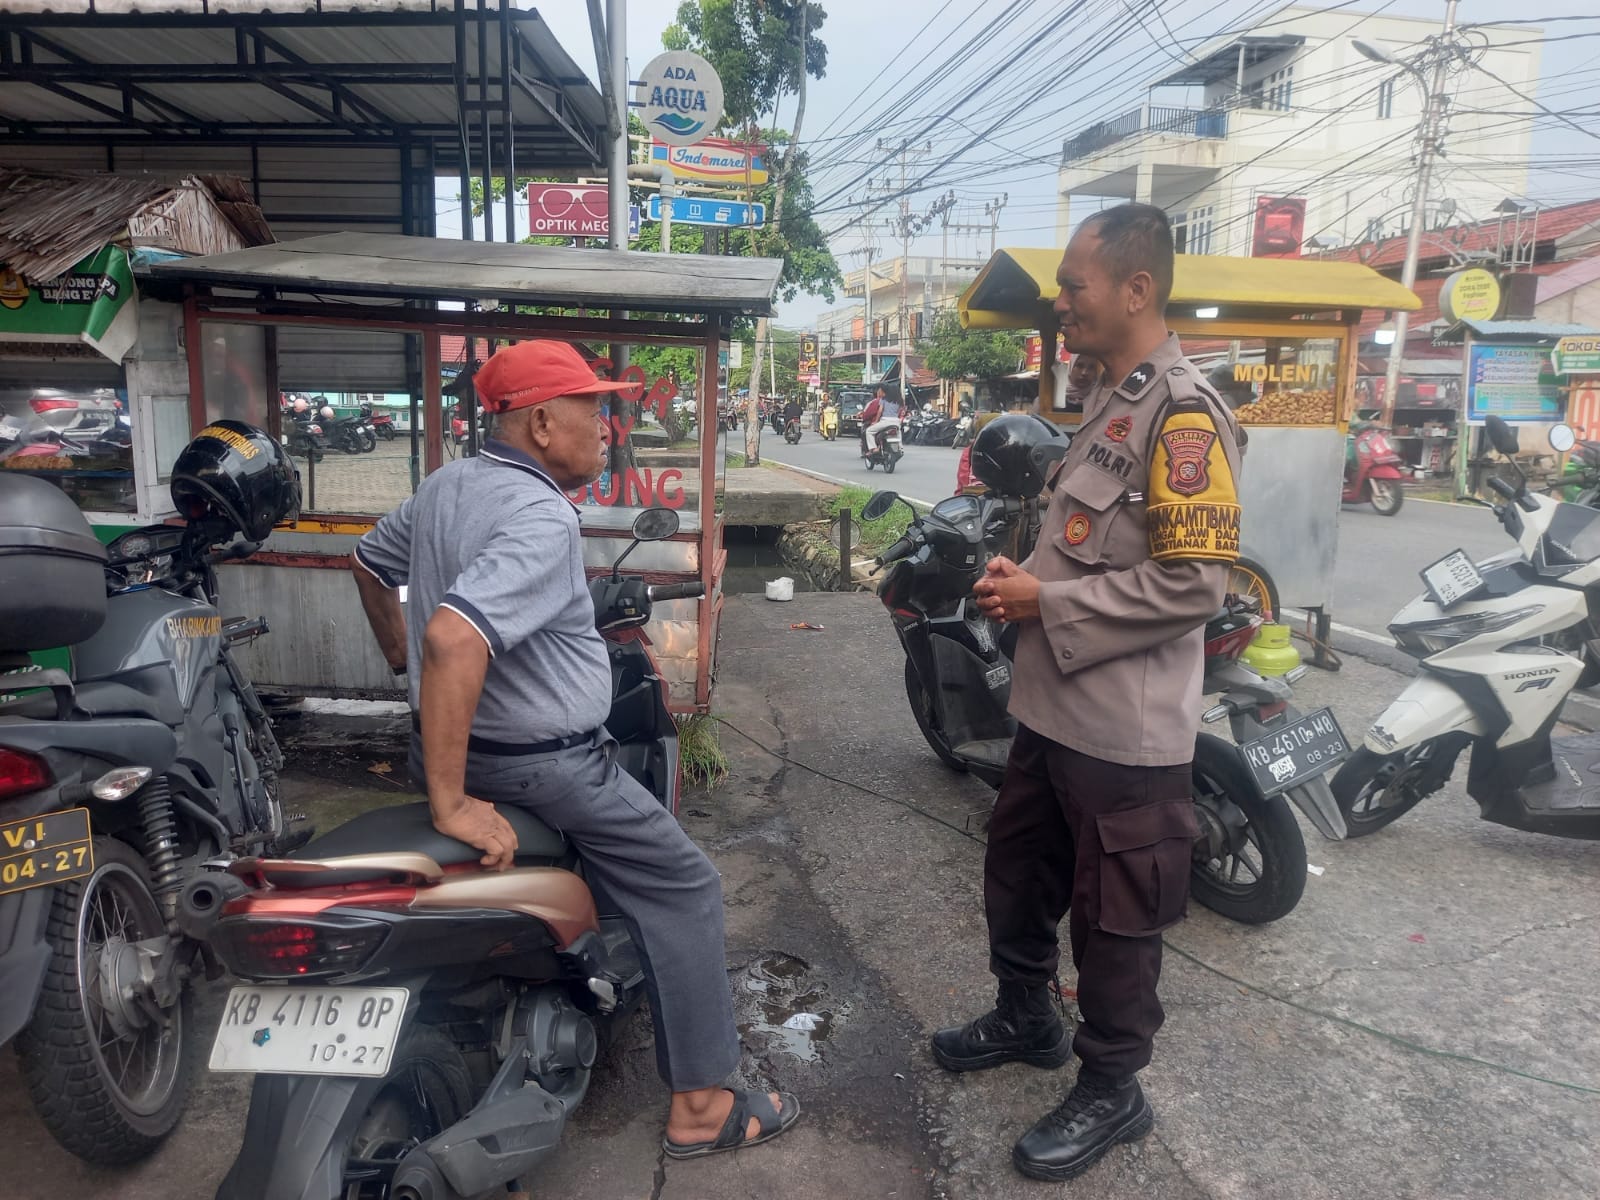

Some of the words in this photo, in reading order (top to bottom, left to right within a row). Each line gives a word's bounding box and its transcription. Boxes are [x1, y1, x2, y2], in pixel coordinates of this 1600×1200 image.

[663, 66, 697, 82] ADA
[649, 86, 708, 114] AQUA
[673, 149, 747, 168] Indomaret
[535, 218, 578, 232] OPTIK
[1086, 442, 1134, 478] POLRI
[1184, 527, 1210, 539] JAWI
[1503, 667, 1561, 681] HONDA
[1247, 745, 1271, 768] KB
[2, 846, 88, 884] 04-27
[226, 993, 262, 1027] KB
[272, 993, 343, 1027] 4116
